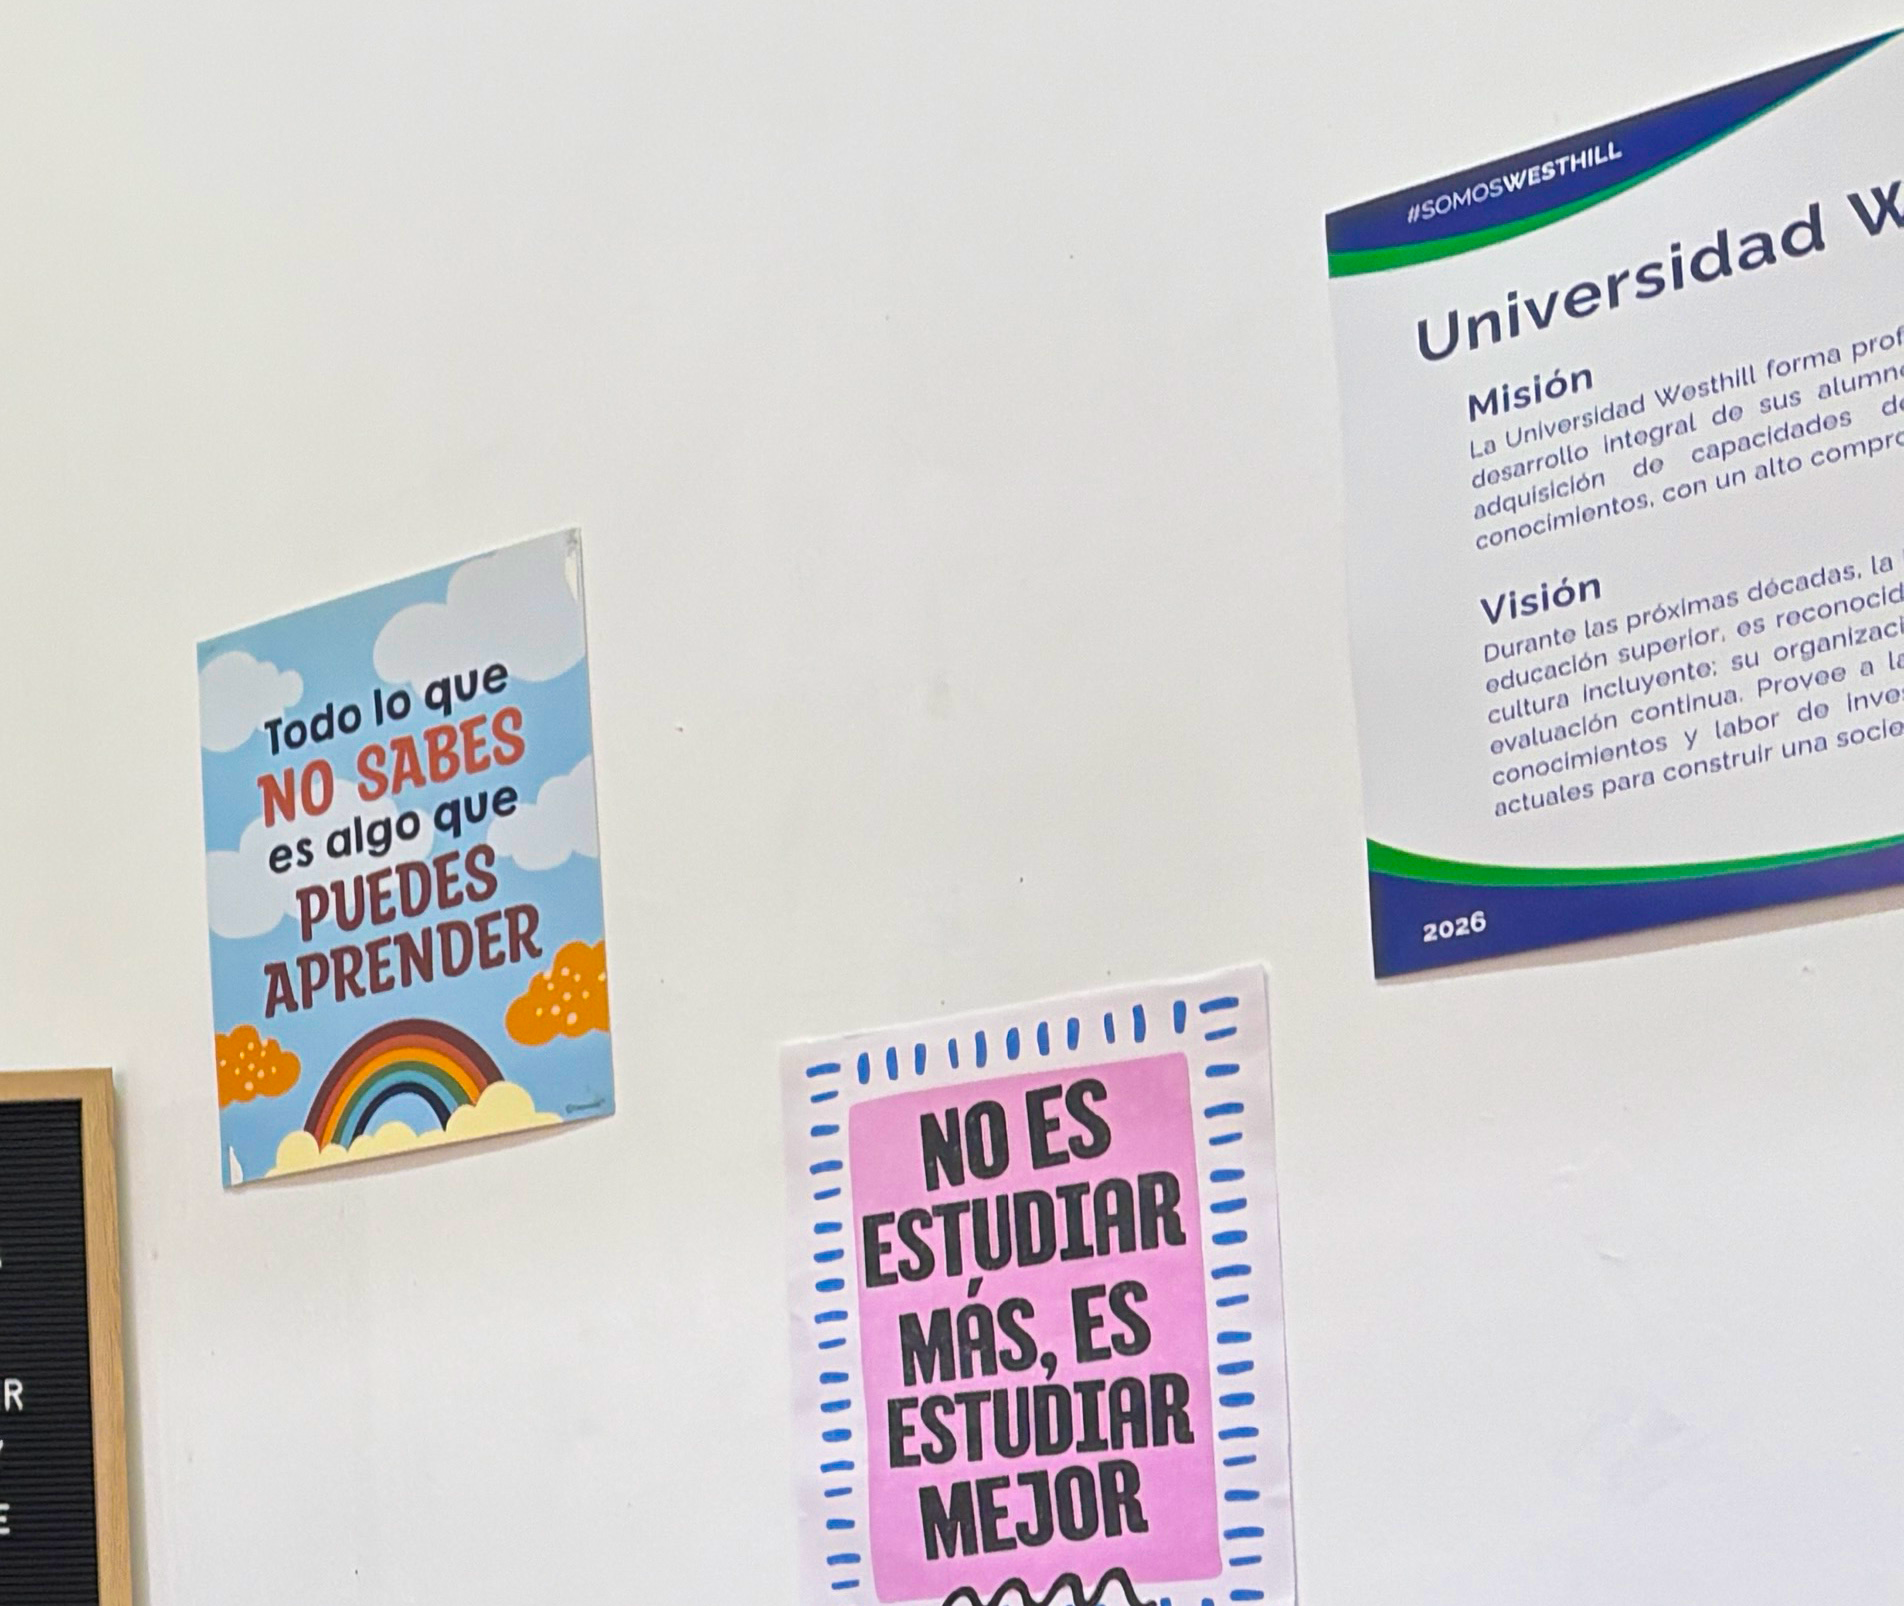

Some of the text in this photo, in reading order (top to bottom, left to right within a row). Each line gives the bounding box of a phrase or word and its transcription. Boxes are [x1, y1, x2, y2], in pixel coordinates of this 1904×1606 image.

[1407, 141, 1622, 223] #SOMOSWESTHILL
[1417, 202, 1825, 362] Universidad
[1469, 366, 1593, 422] Misión
[1470, 436, 1497, 459] La
[1505, 393, 1646, 450] Universidad
[1654, 364, 1756, 409] Westhill
[1767, 346, 1840, 379] forma
[1472, 443, 1588, 489] desarrollo
[1604, 412, 1697, 459] integral
[1712, 402, 1743, 427] de
[1760, 389, 1801, 413] sus
[1474, 470, 1605, 521] adquisición
[1633, 456, 1663, 478] de
[1692, 409, 1852, 465] capacidades
[1476, 492, 1654, 551] conocimientos,
[1662, 477, 1707, 504] con
[1716, 469, 1746, 491] un
[1754, 456, 1802, 481] alto
[1481, 576, 1602, 625] Visión
[1484, 555, 1893, 664] Durante las próximas décadas, la
[1486, 649, 1609, 694] educación
[1737, 617, 1765, 637] es
[1488, 690, 1569, 726] cultura
[1732, 651, 1759, 671] su
[265, 662, 509, 756] Todo lo que
[1490, 710, 1618, 755] evaluación
[1758, 666, 1846, 698] Provee
[1860, 660, 1873, 676] a
[1493, 687, 1904, 787] conocimientos y labor de inve
[257, 706, 526, 828] NO SABES
[1495, 780, 1593, 818] actuales
[1602, 771, 1654, 799] para
[1663, 744, 1772, 783] construir
[1782, 735, 1828, 759] una
[269, 785, 519, 874] es algo que
[296, 843, 498, 943] PUEDES
[1423, 910, 1487, 943] 2026
[263, 903, 543, 1020] APRENDER
[919, 1078, 1112, 1192] NO ES
[862, 1170, 1187, 1289] ESTUDIAR
[898, 1276, 1153, 1387] MÁS, ES
[888, 1371, 1194, 1469] ESTUDIAR
[918, 1459, 1149, 1562] MEJOR
